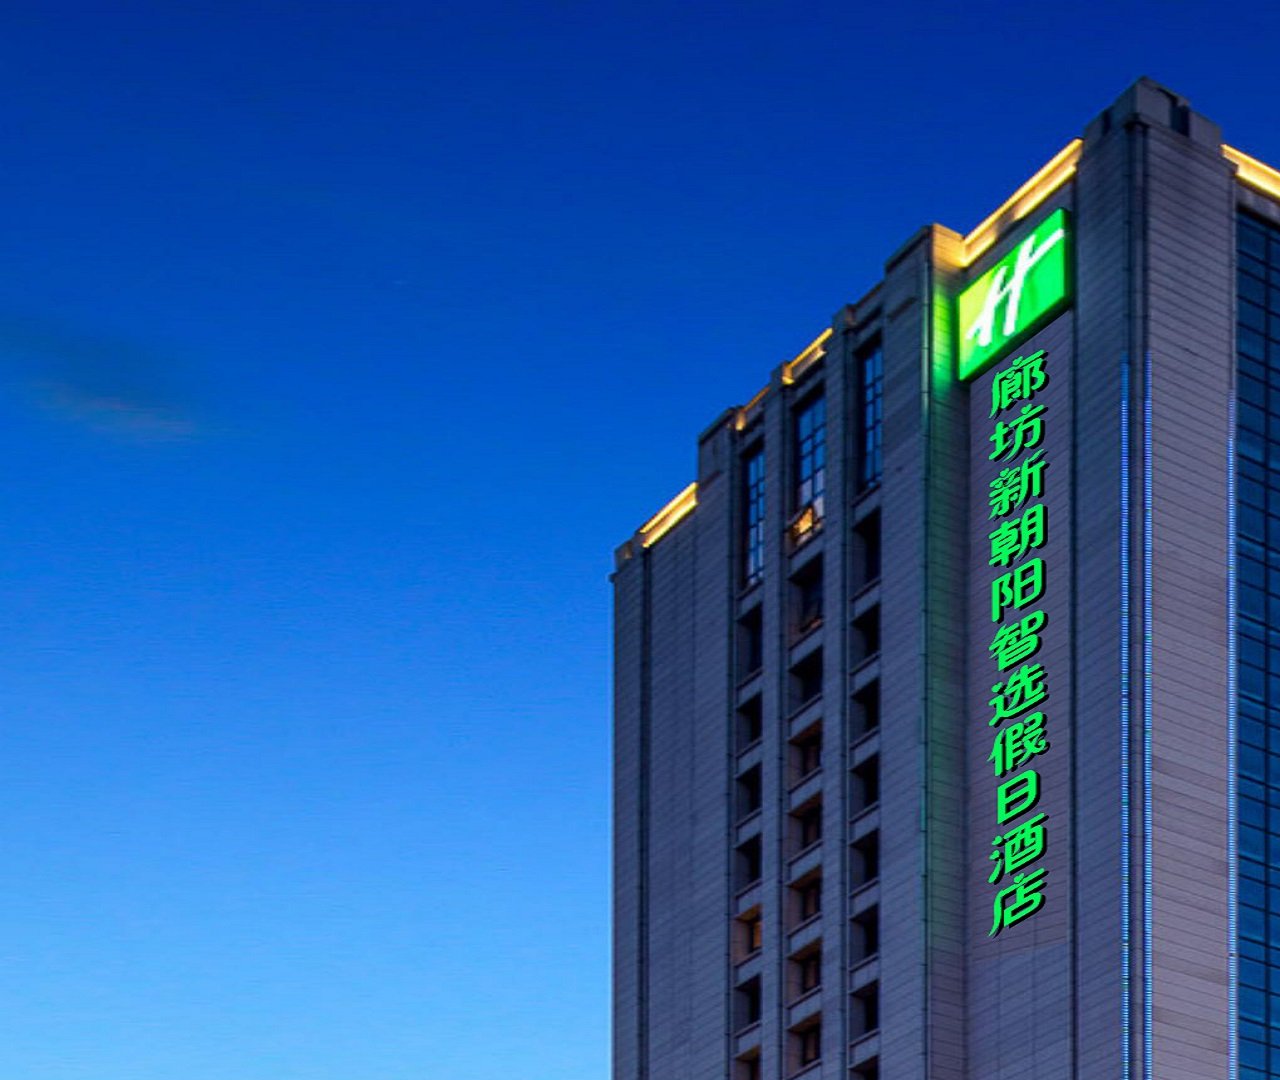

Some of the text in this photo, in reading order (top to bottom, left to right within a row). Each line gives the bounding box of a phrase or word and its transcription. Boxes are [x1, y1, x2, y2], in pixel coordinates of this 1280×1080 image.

[987, 349, 1048, 936] 廊坊新朝阳智选假日酒店
